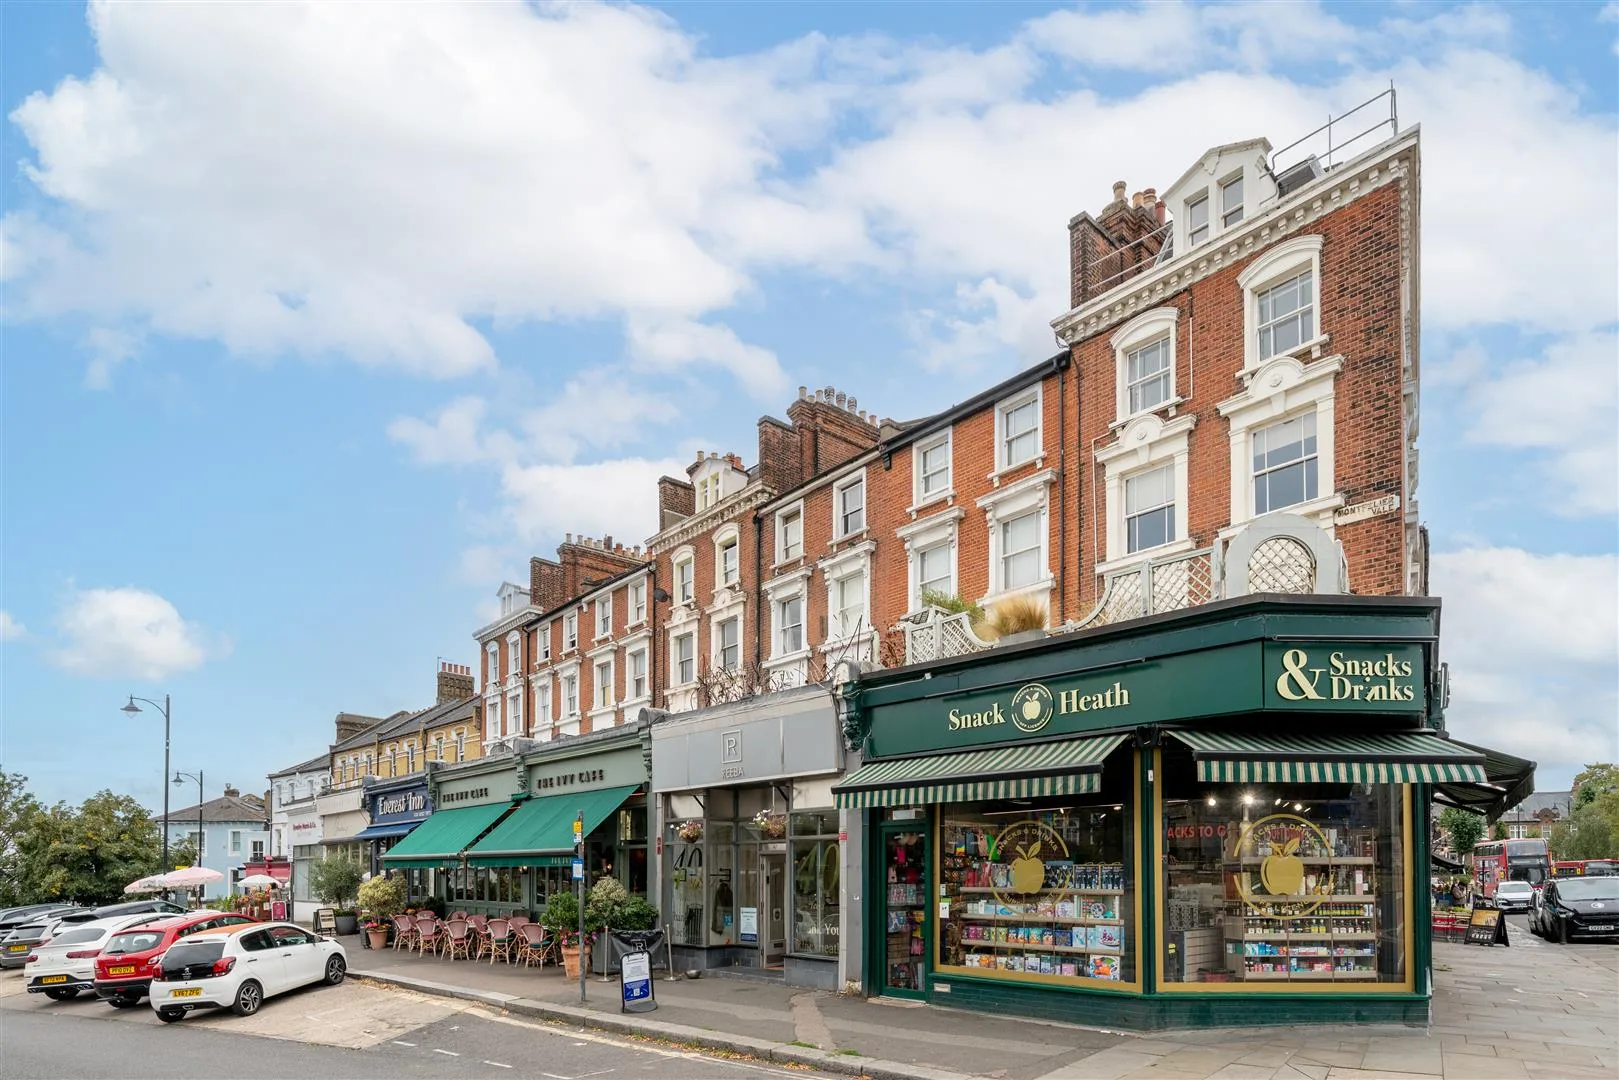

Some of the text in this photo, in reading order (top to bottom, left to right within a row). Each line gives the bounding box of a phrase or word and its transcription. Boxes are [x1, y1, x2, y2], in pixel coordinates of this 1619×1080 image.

[1371, 503, 1394, 516] VALE
[1276, 649, 1412, 700] & Snacks
[1330, 677, 1414, 702] Drinks
[949, 682, 1130, 731] Snack Heath
[727, 737, 737, 756] R
[537, 778, 553, 790] THE
[557, 773, 575, 787] IVY
[378, 791, 425, 816] Everest Inn
[456, 790, 469, 801] IVY
[1031, 828, 1058, 852] DRINKS
[1198, 826, 1213, 838] TO
